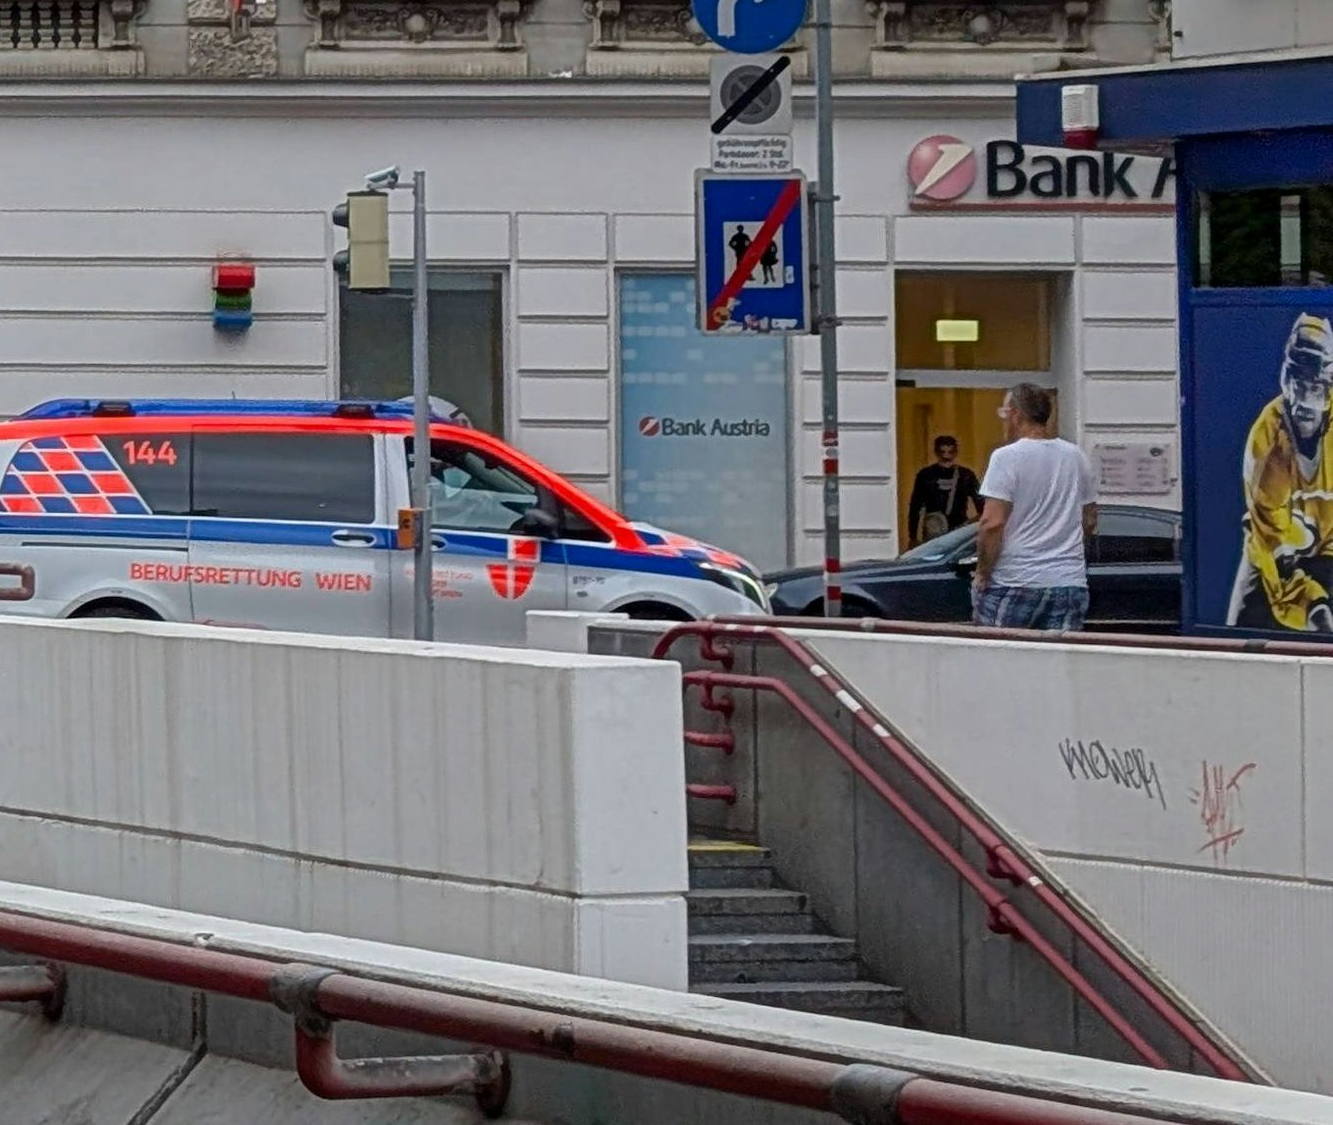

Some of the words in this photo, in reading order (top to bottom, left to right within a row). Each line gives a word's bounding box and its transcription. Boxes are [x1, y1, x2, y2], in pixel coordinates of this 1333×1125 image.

[986, 139, 1138, 199] Bank
[661, 417, 707, 436] Bank
[711, 418, 771, 436] Austria
[123, 440, 177, 466] 144
[129, 562, 302, 589] BERUFSRETTUNG
[315, 571, 374, 593] WIEN
